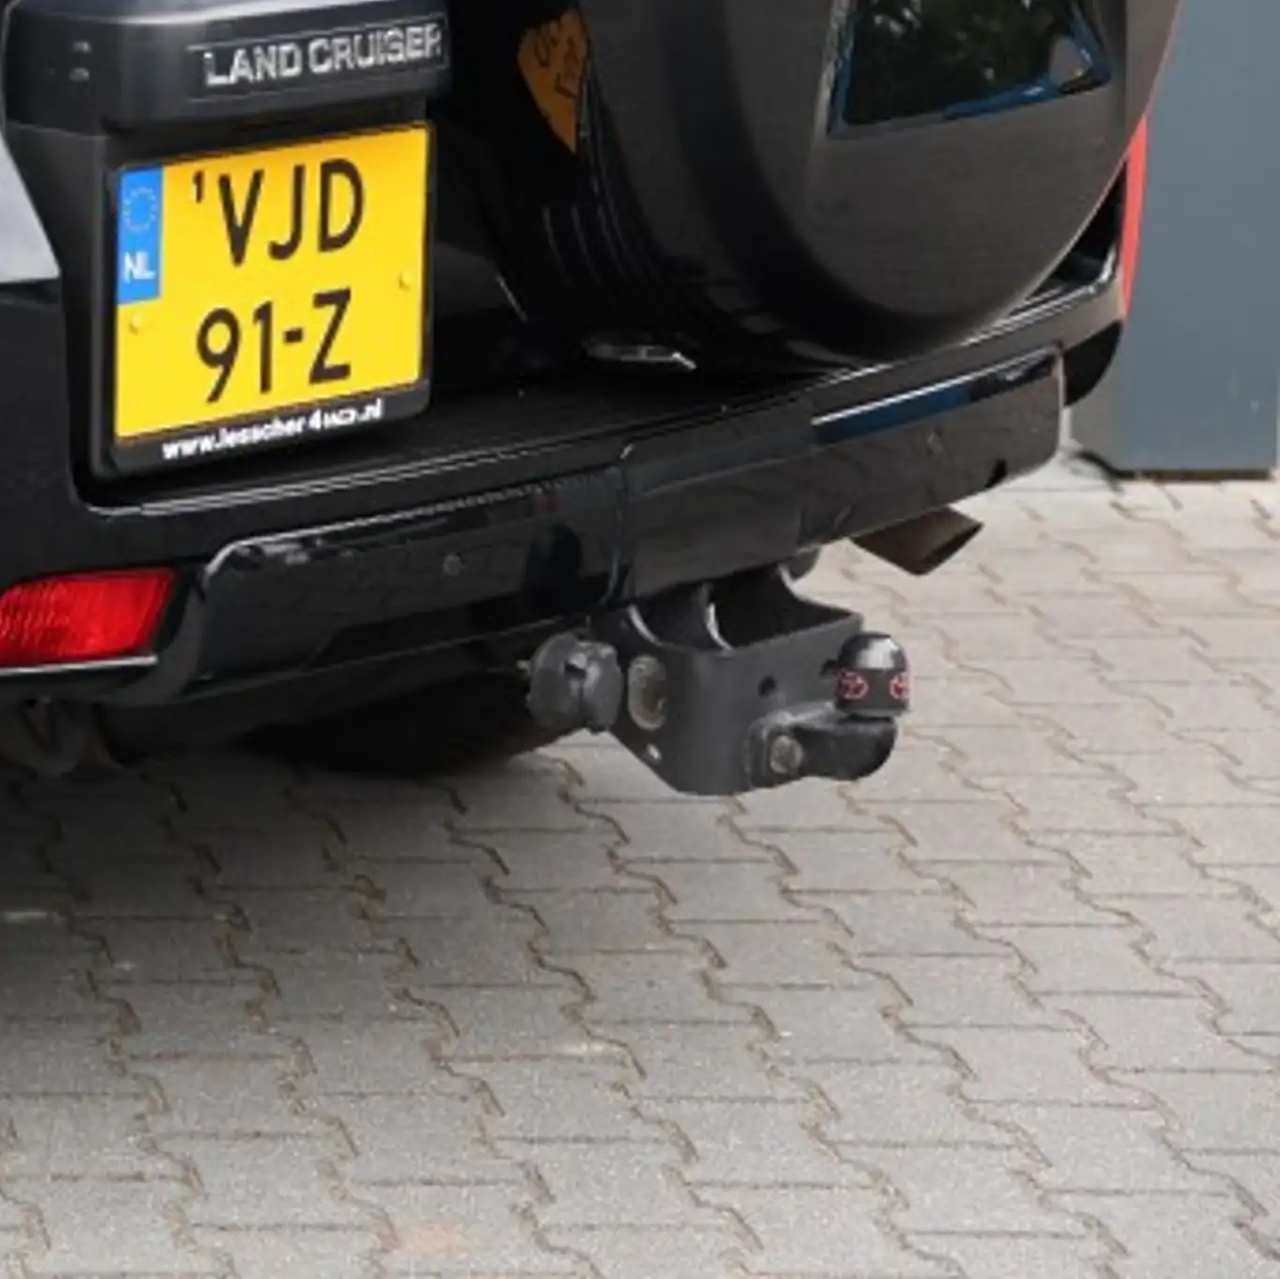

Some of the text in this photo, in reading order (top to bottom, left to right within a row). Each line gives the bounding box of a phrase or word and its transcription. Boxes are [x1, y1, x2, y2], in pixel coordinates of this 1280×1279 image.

[204, 24, 442, 87] LAND CRUISER
[123, 252, 156, 281] NL
[196, 288, 352, 403] 91-Z
